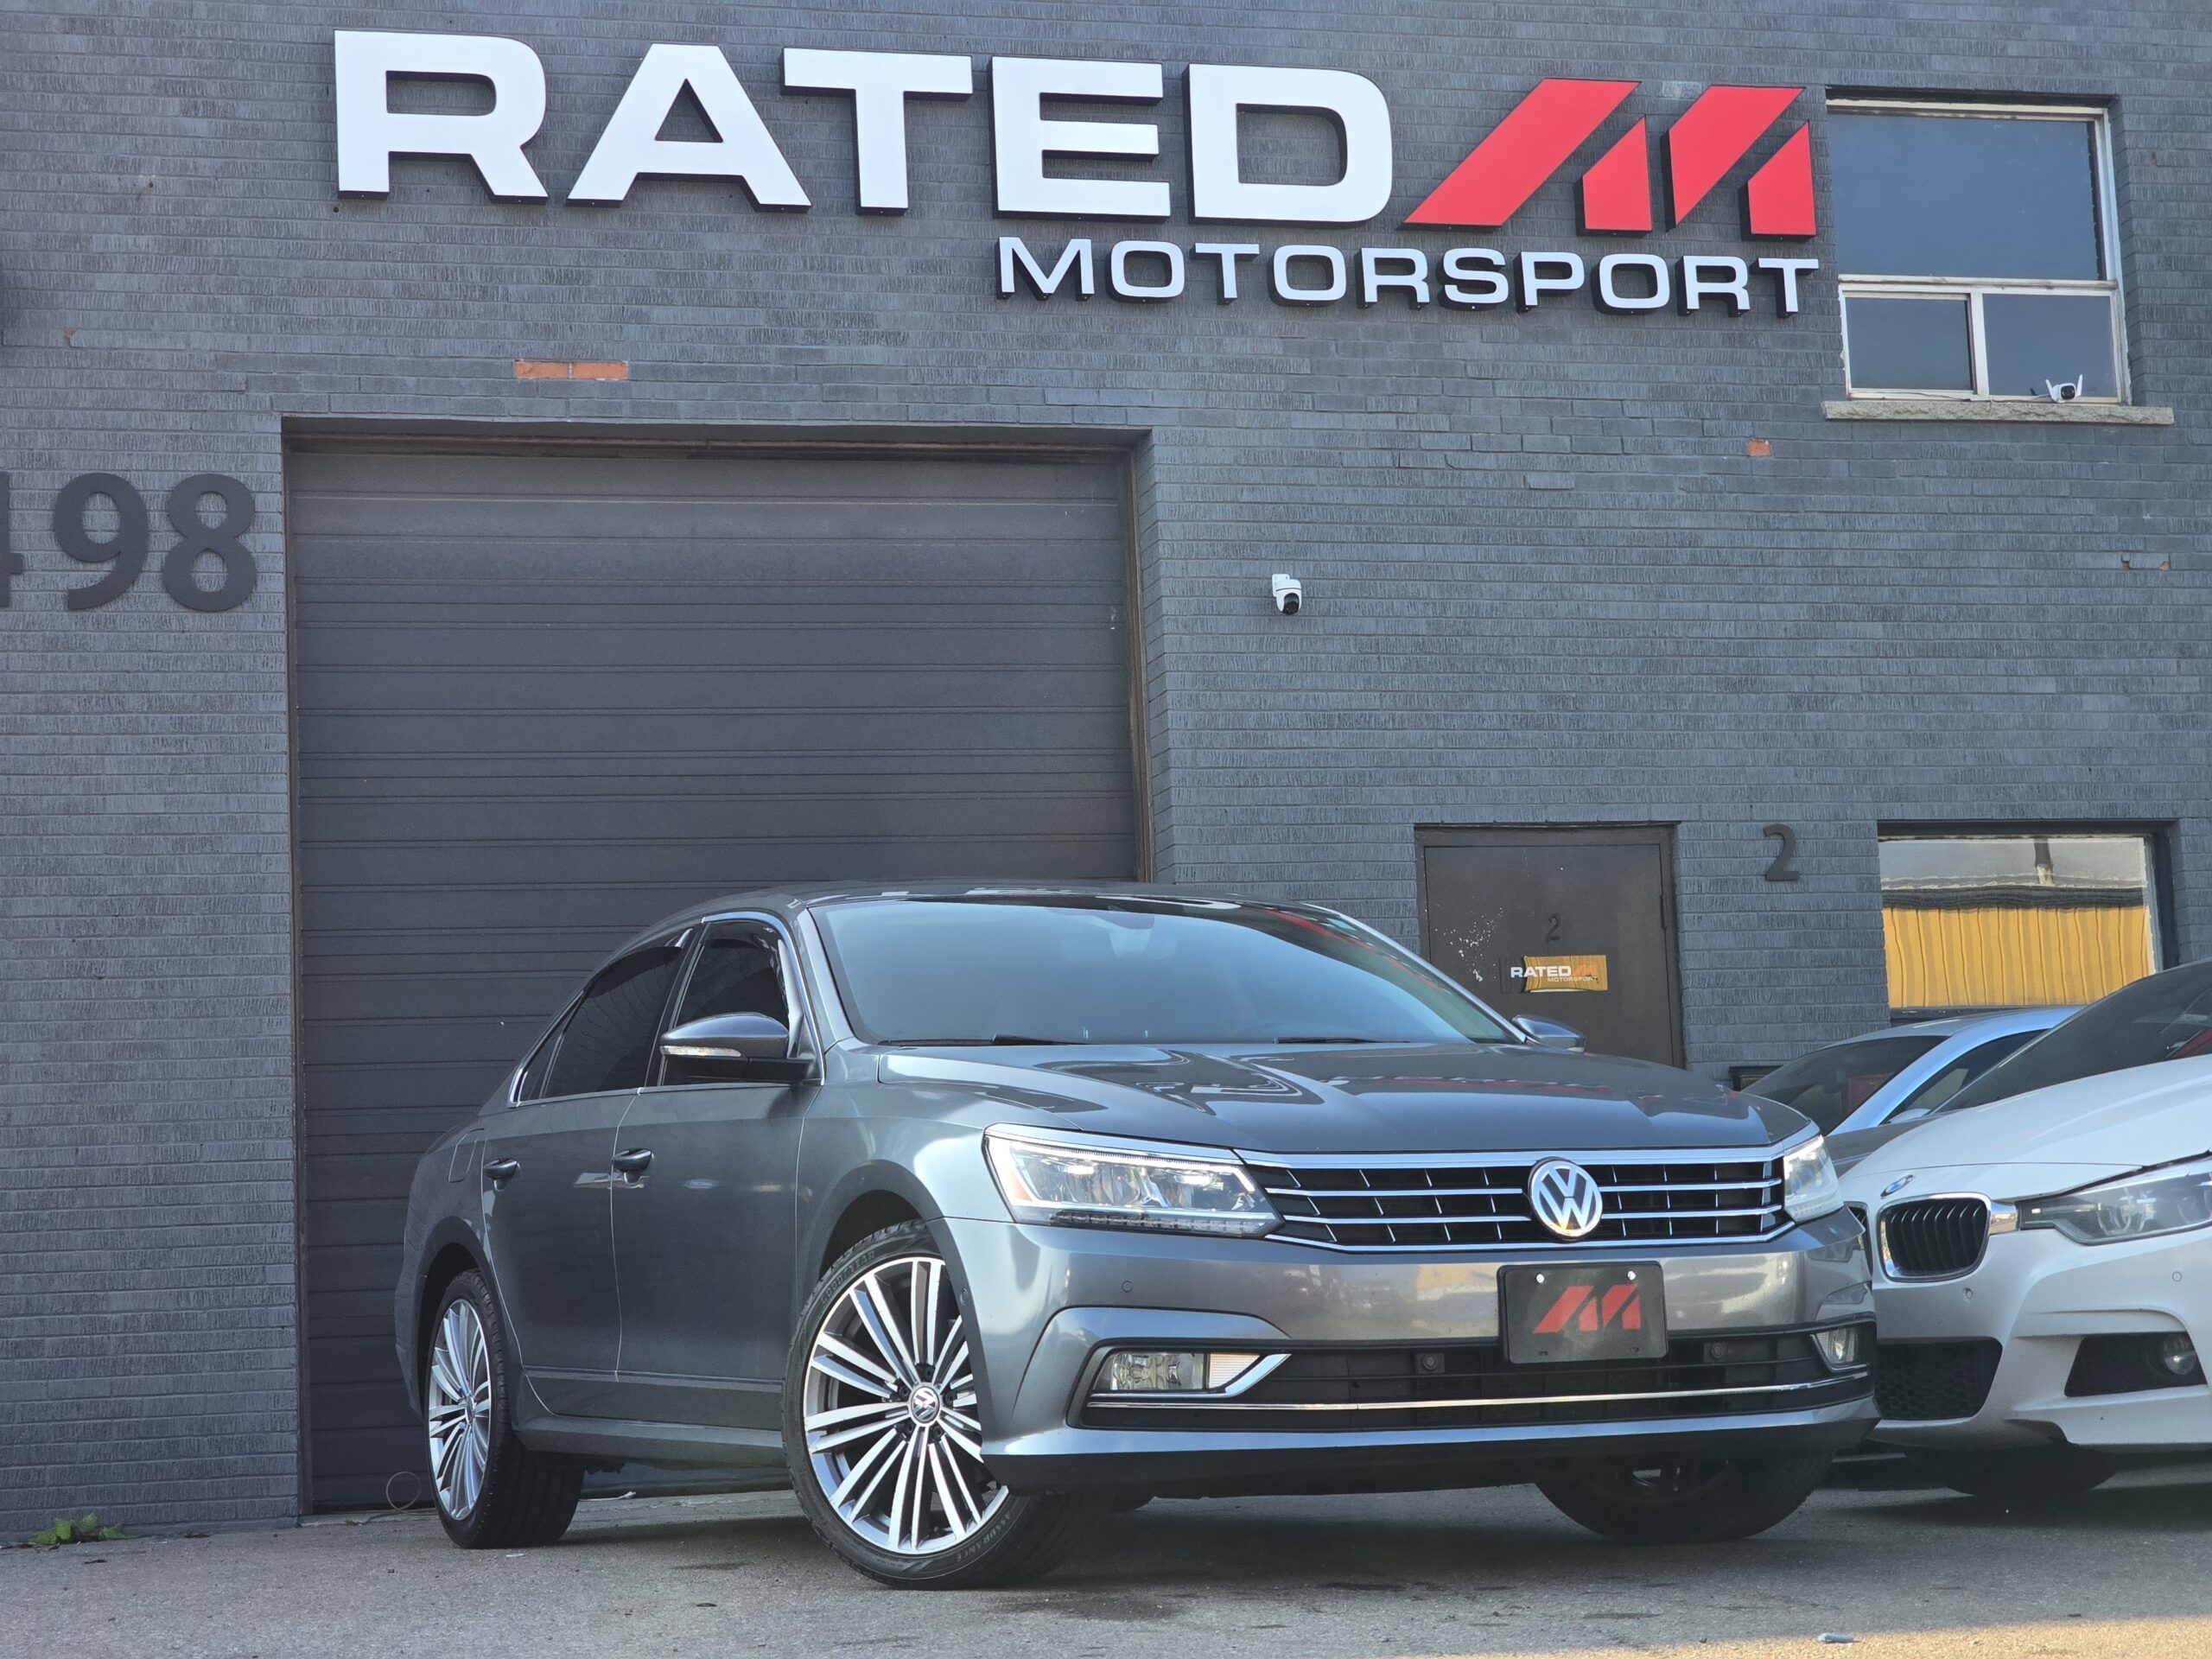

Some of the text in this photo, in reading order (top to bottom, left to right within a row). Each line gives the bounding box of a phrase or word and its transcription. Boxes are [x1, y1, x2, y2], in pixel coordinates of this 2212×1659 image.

[334, 29, 1395, 225] RATED
[997, 236, 1820, 318] MOTORSPORT
[0, 471, 257, 613] 98
[1764, 823, 1800, 881] 2
[1545, 913, 1561, 943] 2
[1510, 965, 1572, 977] RATED
